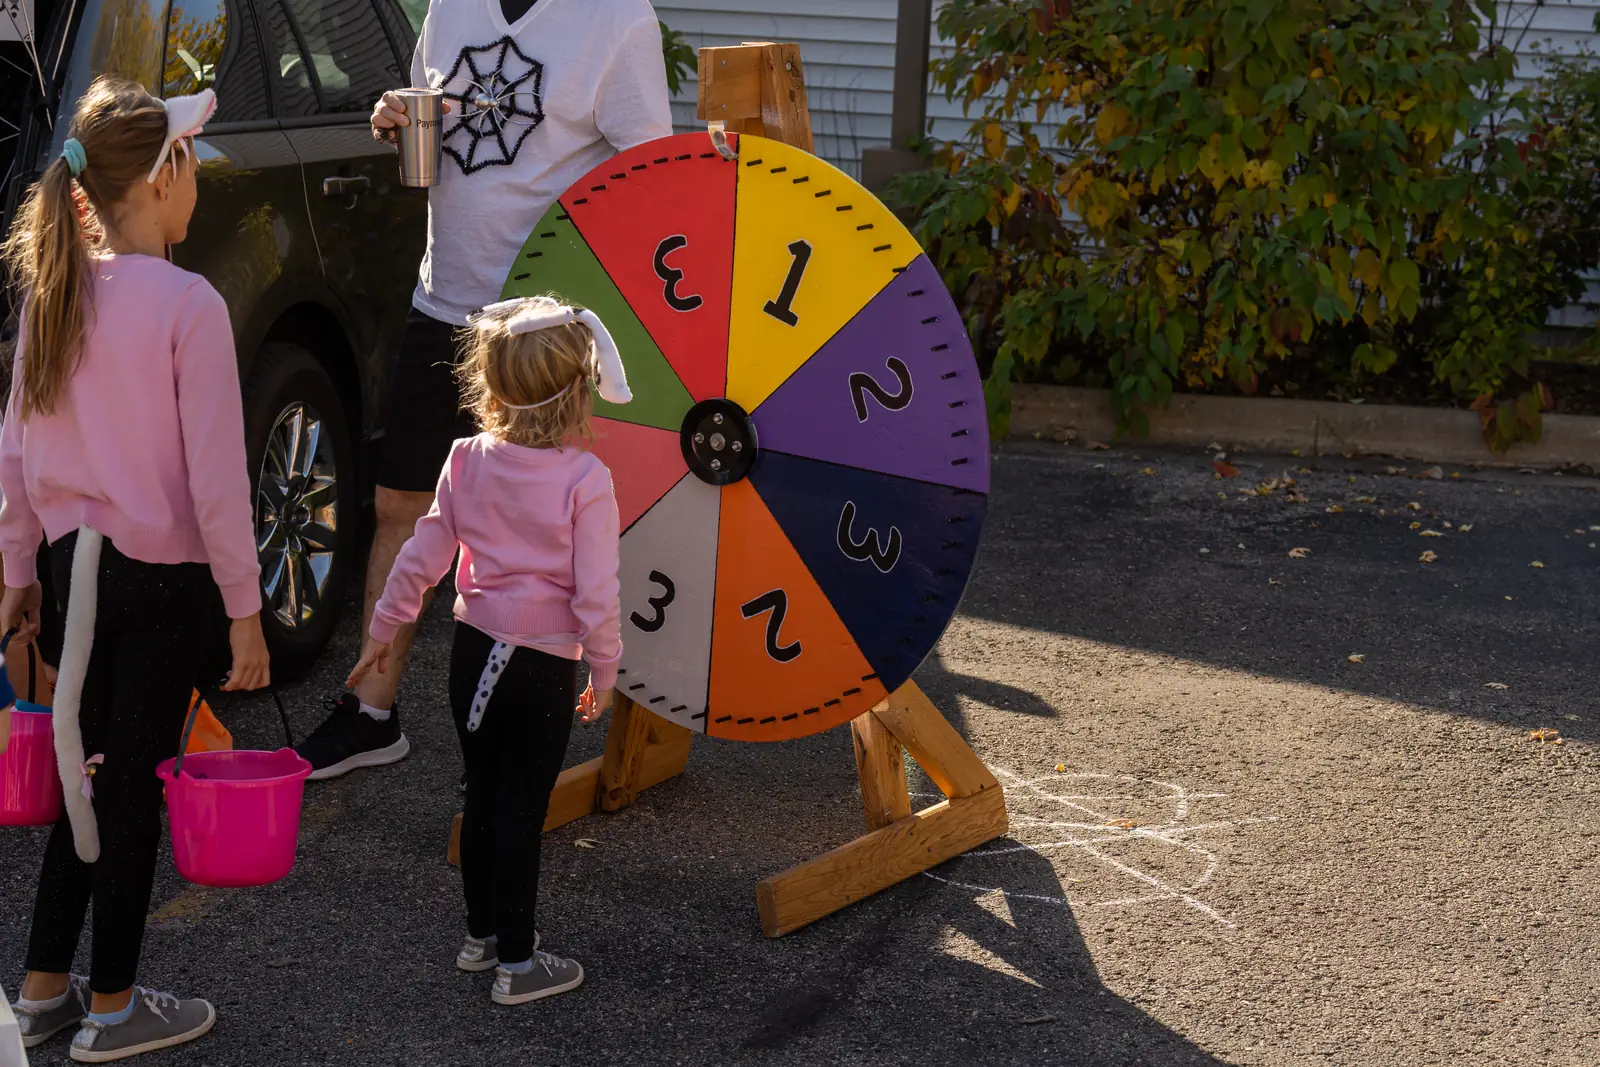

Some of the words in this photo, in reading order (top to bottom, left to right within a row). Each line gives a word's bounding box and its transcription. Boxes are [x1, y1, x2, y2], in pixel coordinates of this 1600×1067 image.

[416, 119, 440, 129] Paym
[652, 234, 703, 312] 3
[763, 239, 812, 327] 1
[848, 356, 914, 423] 2
[836, 501, 902, 573] 3
[629, 569, 675, 632] 3
[740, 588, 802, 663] 2
